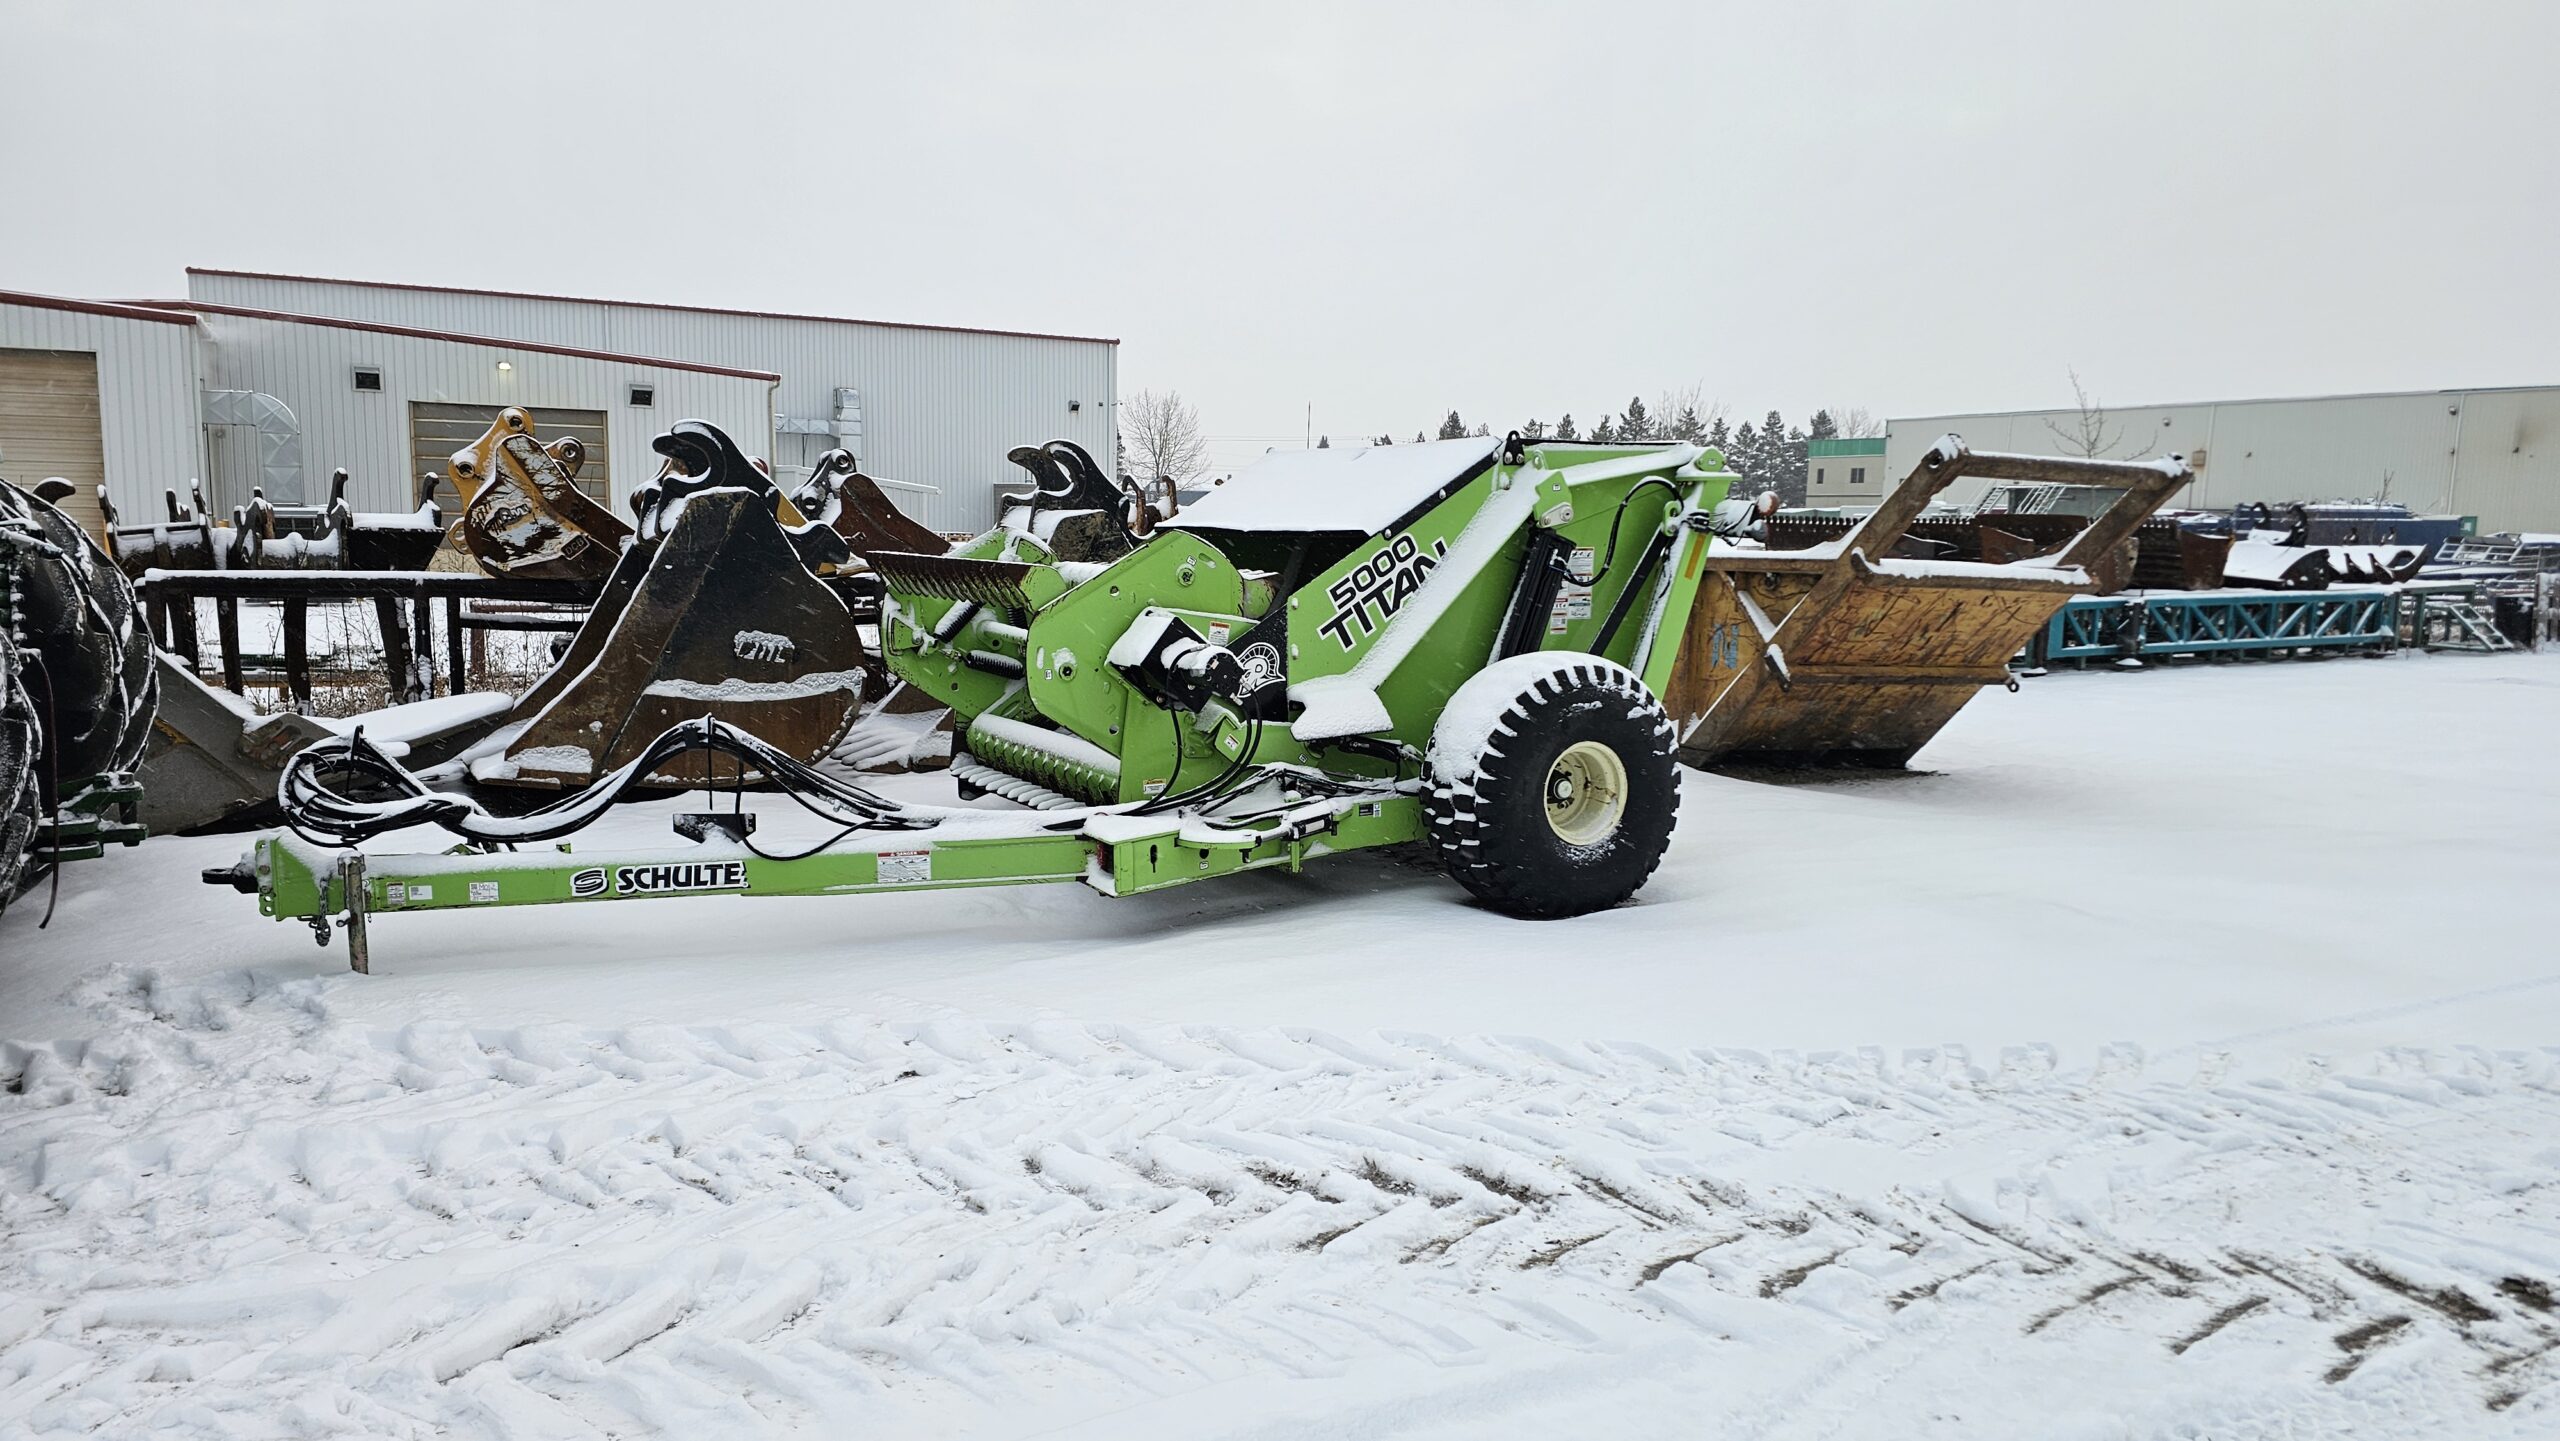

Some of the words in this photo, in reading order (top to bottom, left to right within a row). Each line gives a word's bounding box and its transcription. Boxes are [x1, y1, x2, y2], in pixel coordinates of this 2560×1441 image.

[1319, 540, 1447, 649] TITAN
[1328, 534, 1417, 611] 5000
[617, 862, 742, 892] SCHULTE
